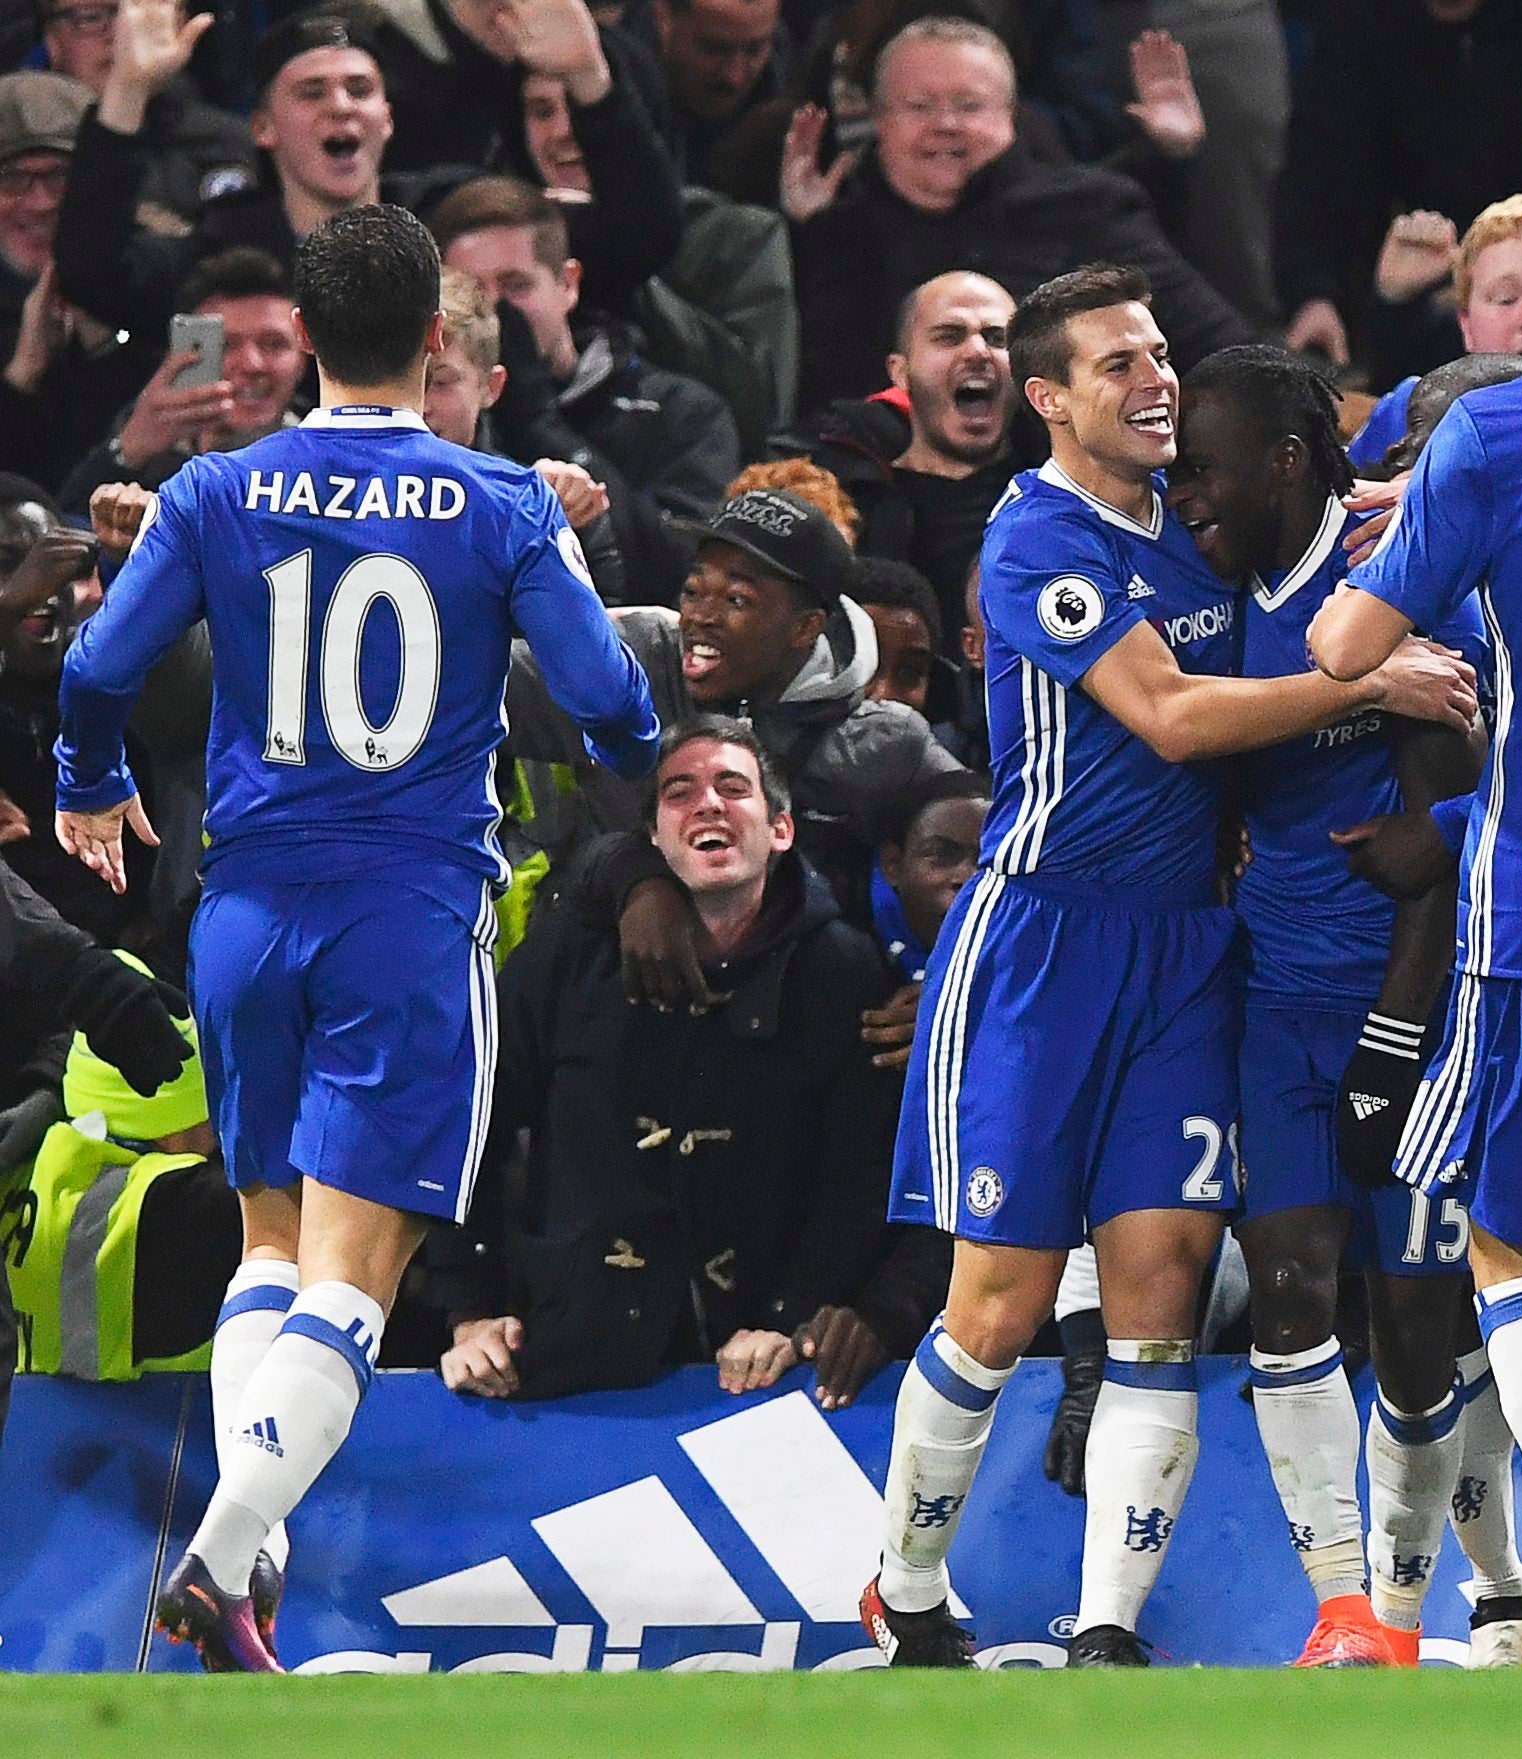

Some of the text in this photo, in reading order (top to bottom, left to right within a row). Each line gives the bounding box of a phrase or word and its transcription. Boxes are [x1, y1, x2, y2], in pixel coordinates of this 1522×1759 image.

[245, 470, 467, 521] HAZARD
[262, 547, 442, 773] 10
[1314, 714, 1381, 748] TYRES
[1349, 1092, 1390, 1107] adidas
[1402, 1187, 1469, 1263] 15
